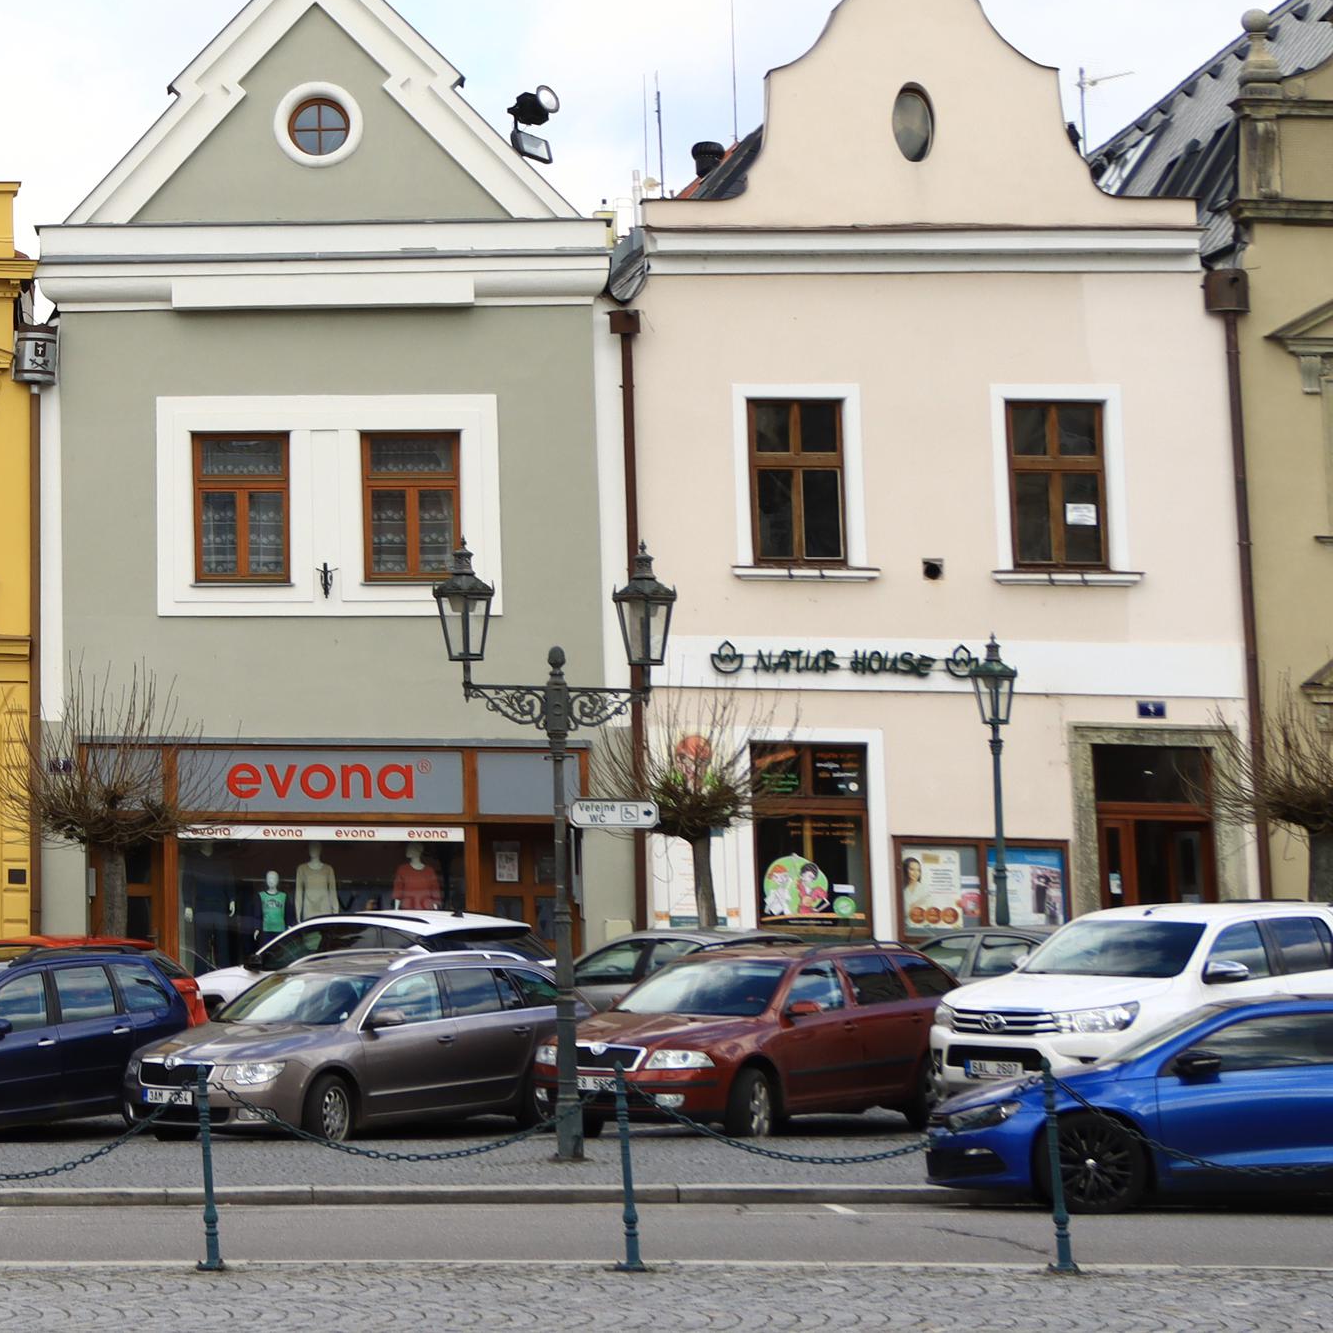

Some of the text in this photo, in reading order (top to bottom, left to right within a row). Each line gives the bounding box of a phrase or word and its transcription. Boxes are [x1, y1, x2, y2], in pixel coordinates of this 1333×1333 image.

[850, 649, 936, 677] HOUSE
[578, 802, 616, 813] Veřejné
[589, 814, 606, 823] WC
[262, 827, 303, 838] evona
[335, 828, 376, 838] evona
[407, 829, 448, 839] evona
